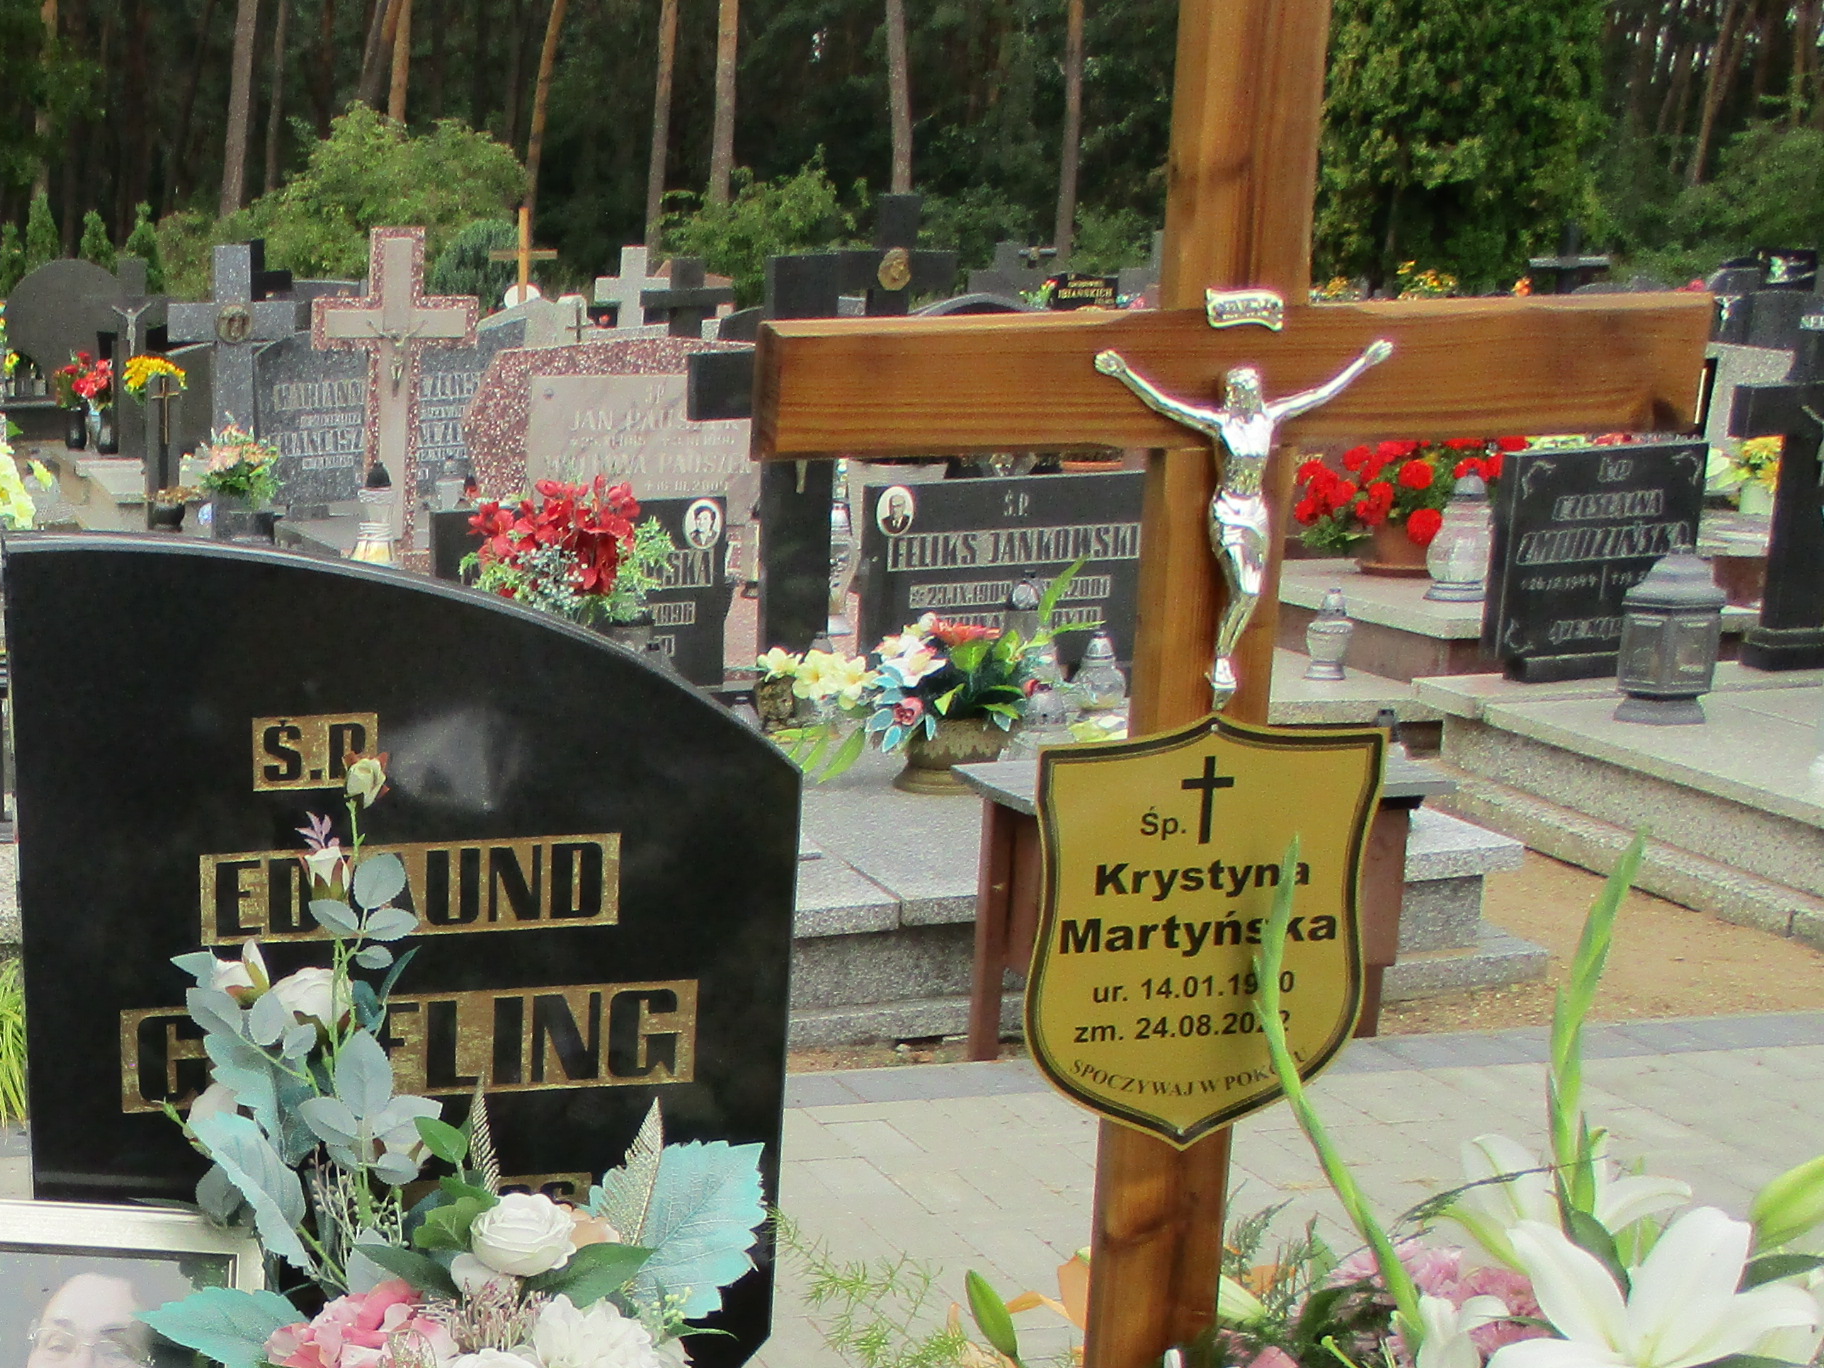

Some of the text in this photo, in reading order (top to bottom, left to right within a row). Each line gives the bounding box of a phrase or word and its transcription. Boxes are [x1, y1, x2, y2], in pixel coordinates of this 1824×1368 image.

[890, 524, 1138, 568] FELIKS JANKOWSKI
[1140, 805, 1188, 841] Śp.
[214, 840, 603, 939] EDUND
[1094, 859, 1311, 902] Krystyna
[1093, 970, 1295, 1004] ur. 14.01.190
[1074, 1009, 1291, 1043] zm. 24.08.202
[1069, 1059, 1195, 1097] SPOCZYWAJ
[1197, 1078, 1218, 1093] W
